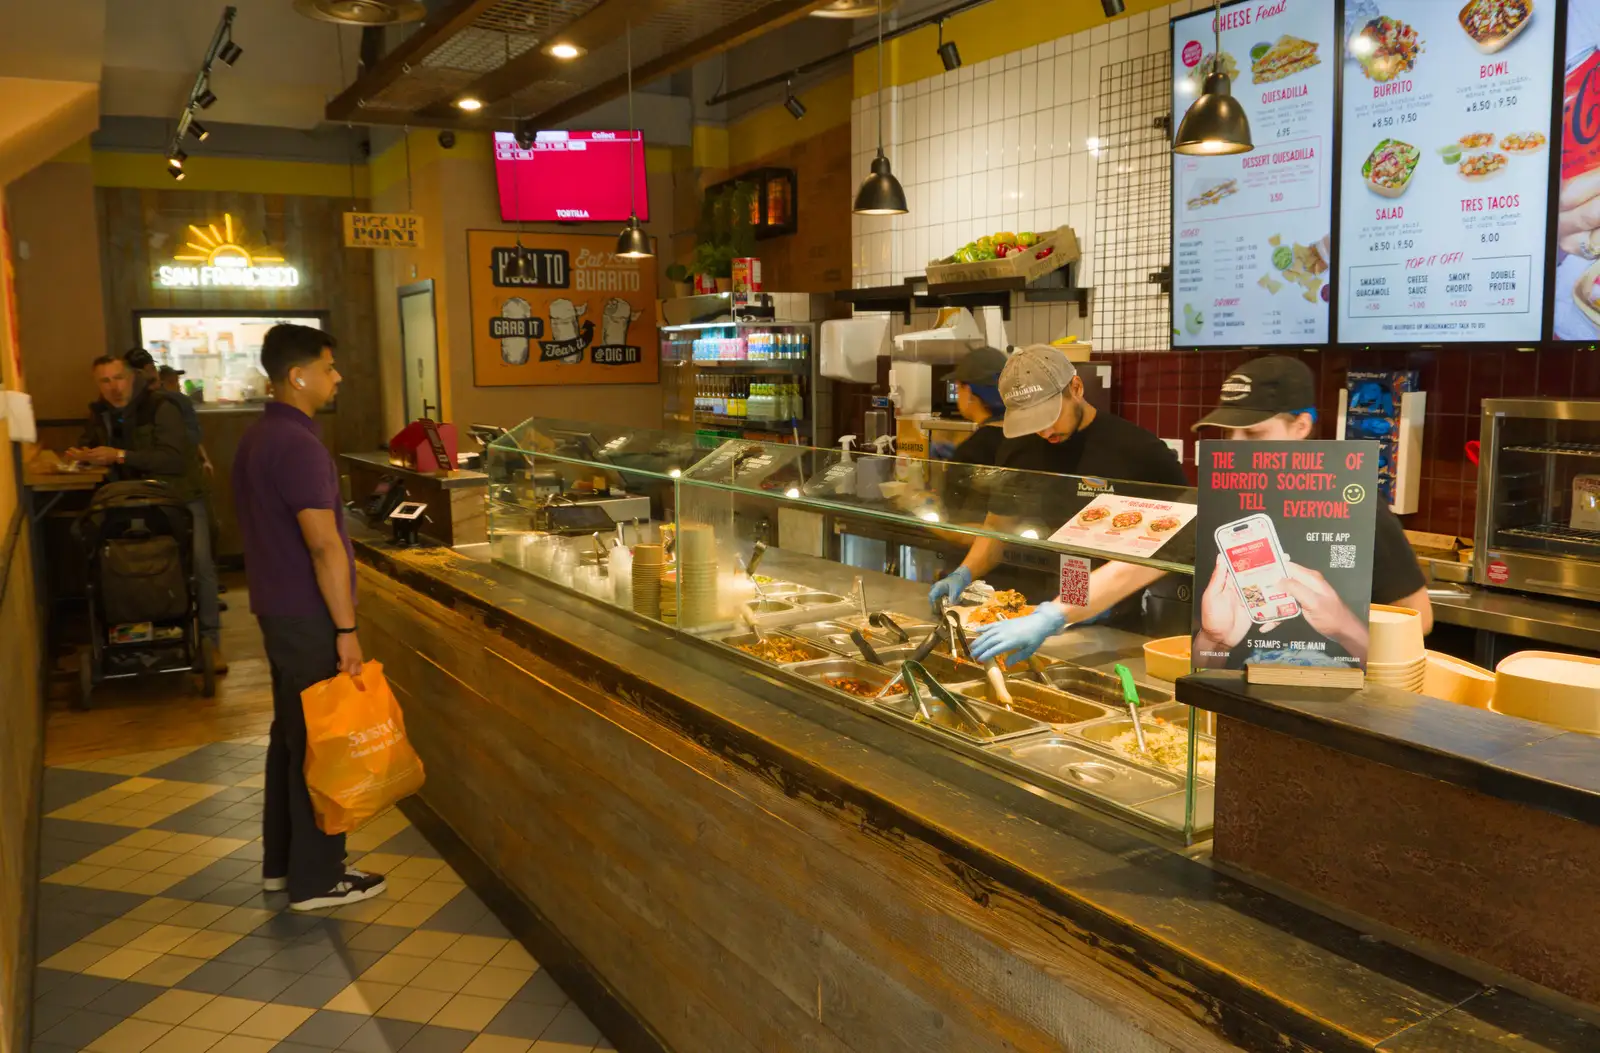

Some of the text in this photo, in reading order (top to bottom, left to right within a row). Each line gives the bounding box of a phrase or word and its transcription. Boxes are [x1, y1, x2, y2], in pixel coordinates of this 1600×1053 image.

[1212, 0, 1288, 33] CHEESE Feast
[1480, 61, 1509, 78] BOWL
[1262, 84, 1308, 104] QUESADILLA
[1373, 79, 1413, 98] BURRITO
[1499, 96, 1517, 108] 9.50
[1400, 112, 1417, 124] 9.50
[1277, 127, 1291, 138] 6.95
[1242, 147, 1315, 169] DESSERT QUESADILLA
[1460, 194, 1520, 212] TRES TACOS
[556, 209, 590, 218] TORTILLA
[1375, 206, 1404, 220] SALAD
[352, 215, 417, 229] PICK UP
[353, 227, 418, 241] POINT
[1481, 232, 1499, 243] 8.00
[1397, 239, 1414, 250] 9.50
[575, 248, 604, 268] Eat
[1405, 252, 1464, 270] TOP IT OFF!
[159, 265, 299, 287] SAN FRANCISCO
[543, 253, 564, 285] TO
[1490, 270, 1516, 280] DOUBLE
[575, 269, 640, 292] BURRITO
[1360, 277, 1386, 287] SMASHED
[1407, 275, 1428, 284] CHEESE
[1449, 273, 1470, 282] SMOKY
[1356, 287, 1390, 297] GUACAMOLE
[1408, 286, 1427, 295] SAUCE
[1445, 283, 1473, 293] CHORIZO
[1489, 281, 1516, 291] PROTEIN
[494, 320, 539, 335] GRAB IT
[545, 336, 586, 357] Tear it
[605, 347, 623, 361] DIG
[625, 348, 636, 361] IN
[1211, 452, 1364, 470] THE FIRST RULE OF
[1211, 472, 1337, 491] BURRITO SOCIETY:
[1239, 493, 1350, 519] TELL EVERYONE
[1306, 532, 1350, 542] GET THE APP
[1247, 639, 1252, 648] 5
[1254, 640, 1281, 649] STAMPS
[1290, 641, 1306, 650] FREE
[1307, 641, 1326, 650] MAIN
